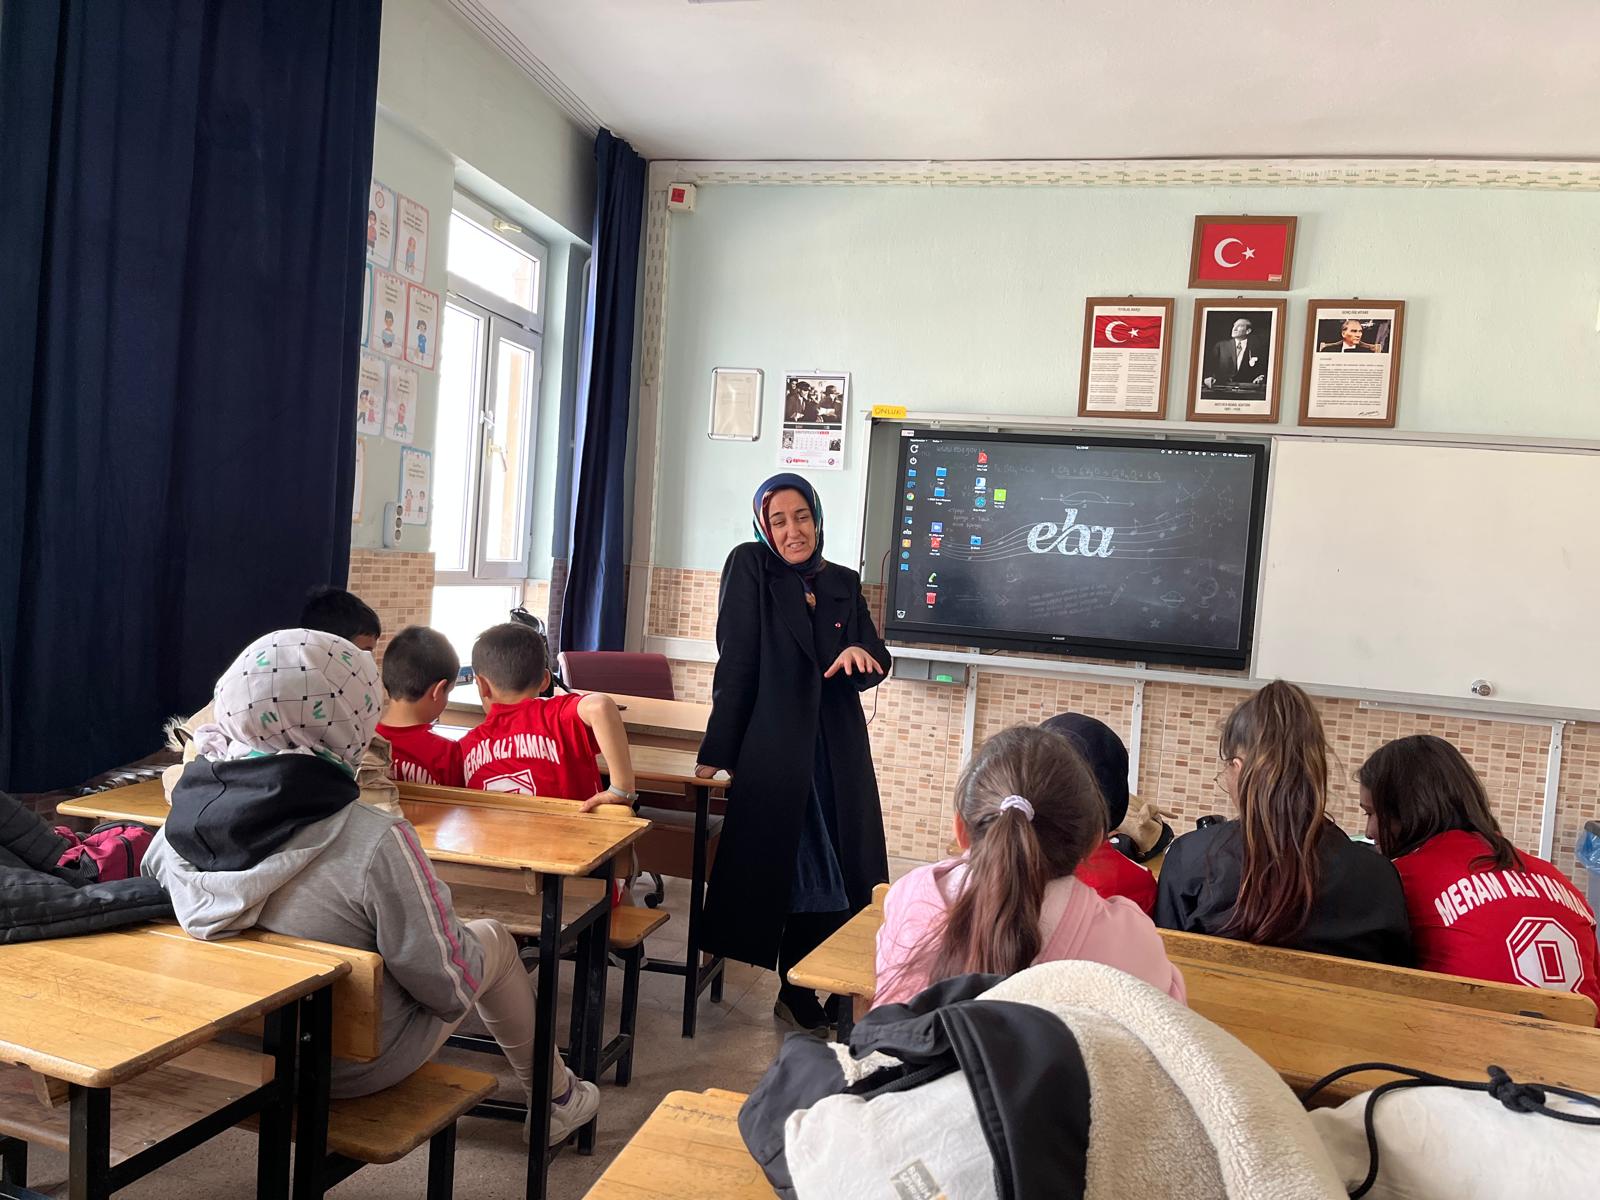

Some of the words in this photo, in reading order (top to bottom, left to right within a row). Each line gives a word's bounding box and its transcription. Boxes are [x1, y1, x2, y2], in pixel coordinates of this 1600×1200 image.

[1026, 507, 1115, 558] eba
[514, 733, 560, 765] YAMAN
[401, 760, 441, 786] YAM
[1434, 871, 1508, 927] MERAM
